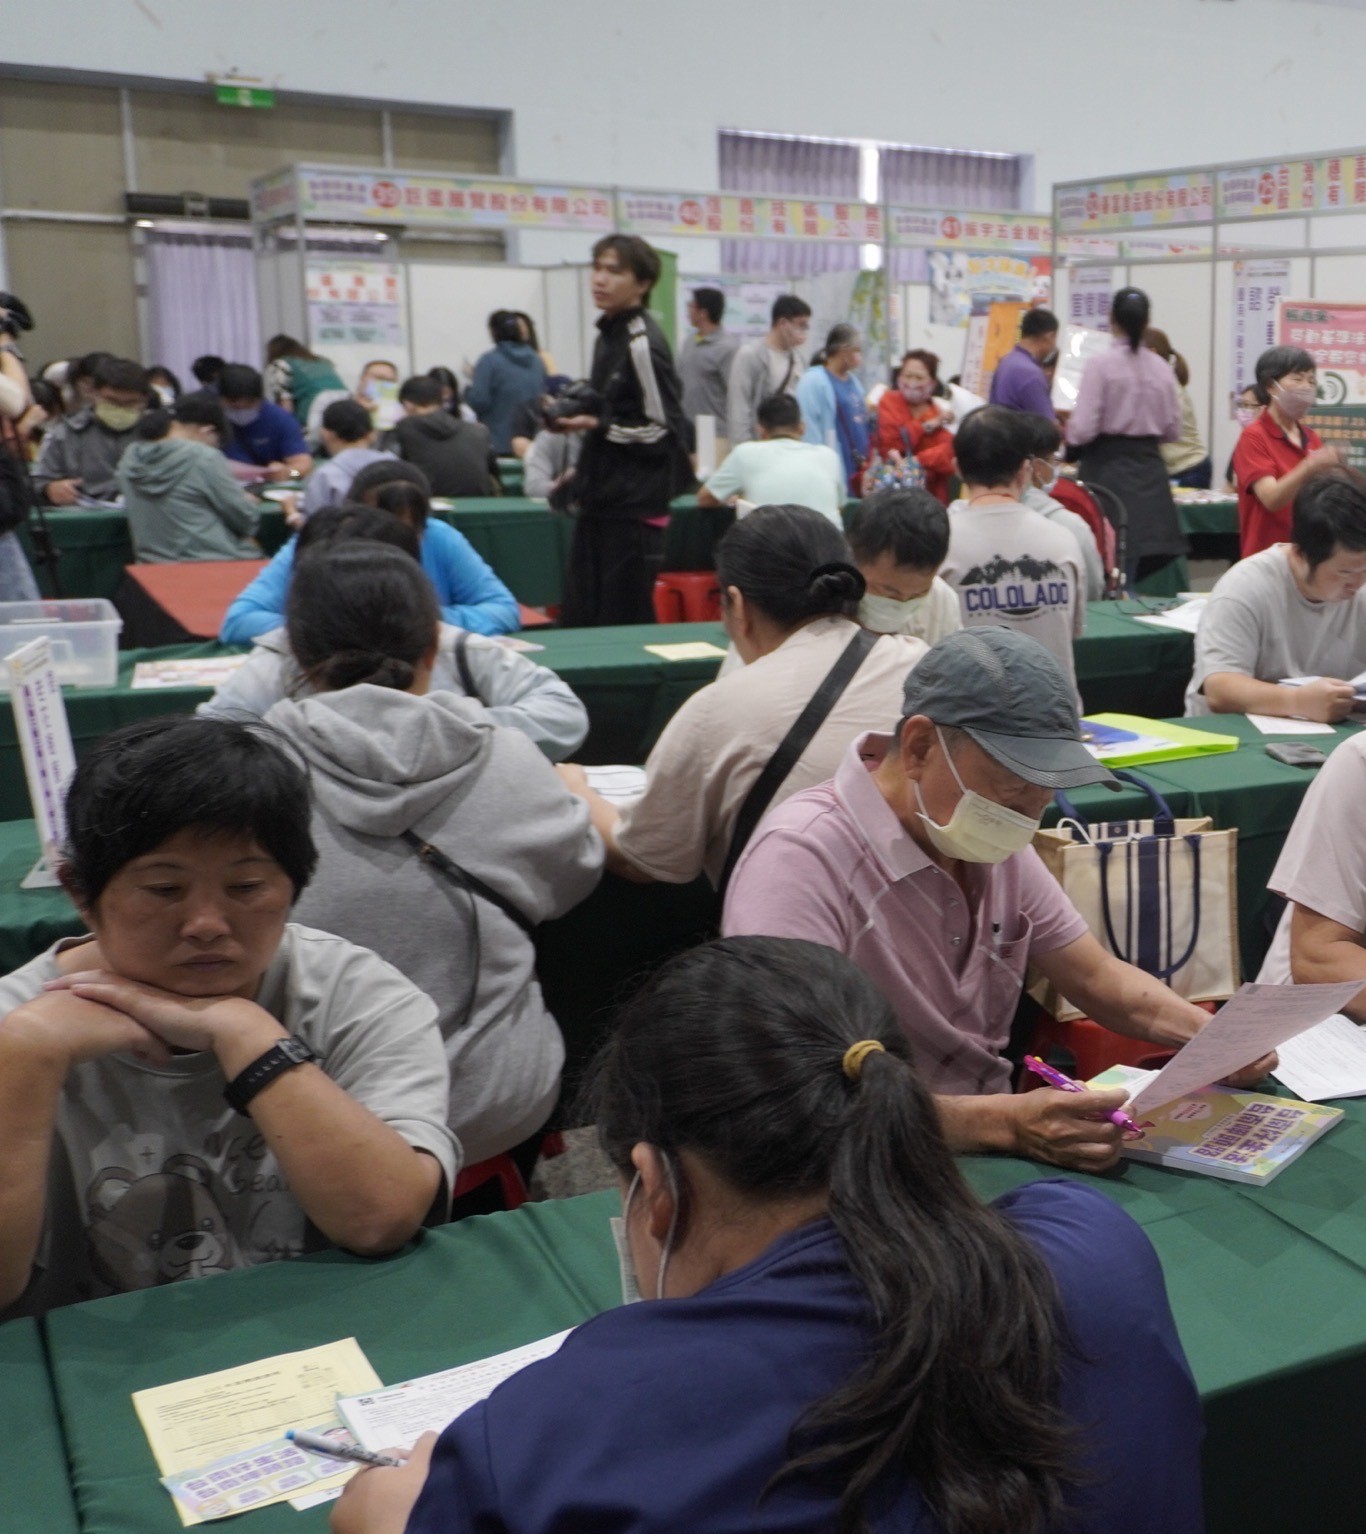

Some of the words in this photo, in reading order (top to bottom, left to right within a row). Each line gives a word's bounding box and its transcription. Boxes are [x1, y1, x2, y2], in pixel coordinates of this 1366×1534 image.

[965, 582, 1068, 612] COLOLADO
[1221, 1107, 1306, 1164] 台南好生活
